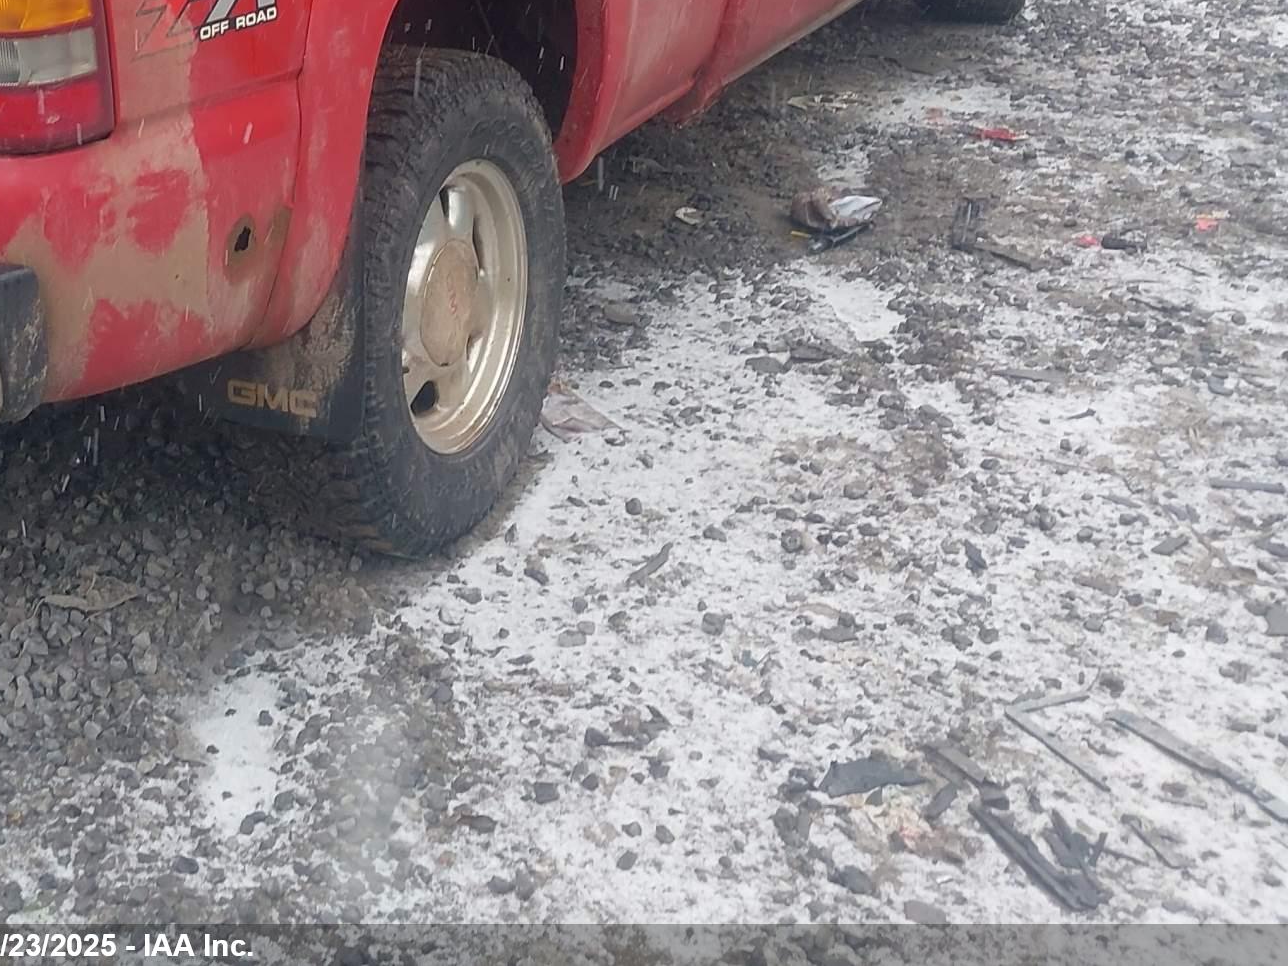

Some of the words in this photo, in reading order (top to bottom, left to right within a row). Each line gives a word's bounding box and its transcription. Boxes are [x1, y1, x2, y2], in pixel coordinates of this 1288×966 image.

[199, 20, 230, 41] OFF
[235, 7, 278, 30] ROAD
[227, 379, 318, 418] GMC
